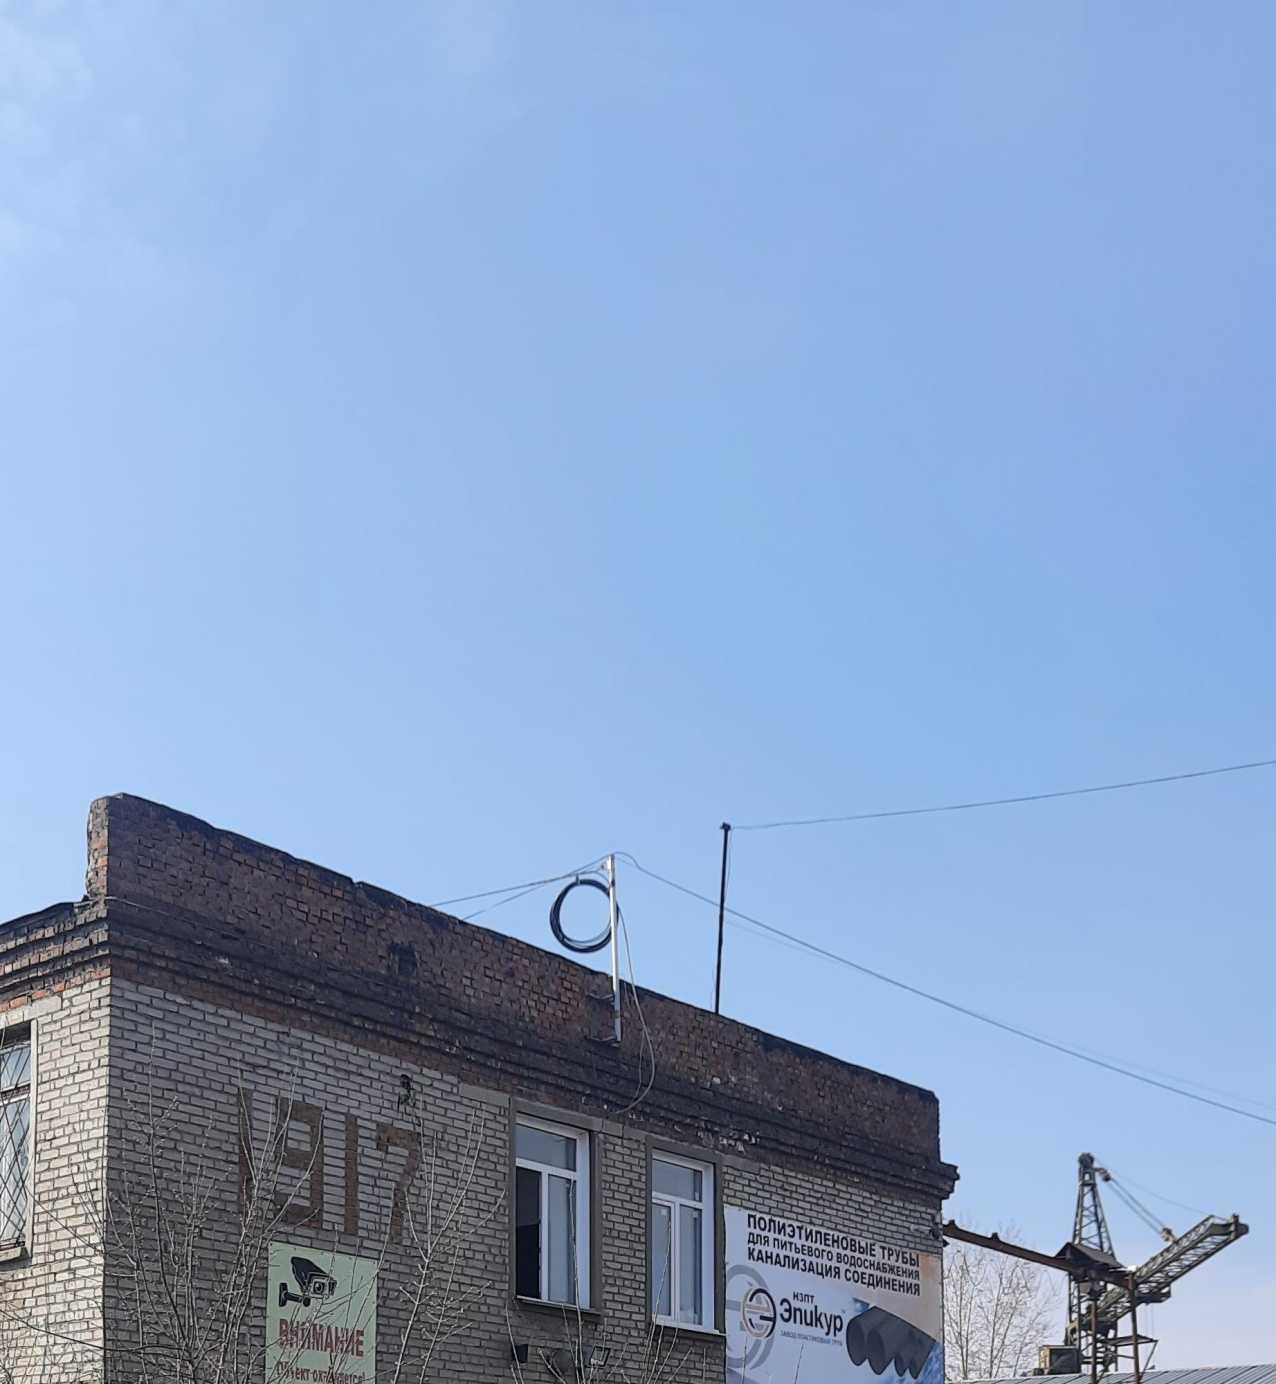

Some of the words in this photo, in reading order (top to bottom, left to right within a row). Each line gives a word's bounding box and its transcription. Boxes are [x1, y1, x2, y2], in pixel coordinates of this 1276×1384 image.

[239, 1086, 420, 1240] 1917
[747, 1213, 876, 1258] ПОЛИЭТИЛЕНОВЫЕ
[879, 1245, 920, 1267] ТРУБЫ
[747, 1232, 770, 1246] ДЛЯ
[773, 1238, 833, 1261] ПИТЬЕВОГО
[836, 1253, 920, 1281] ВОДОСНАБЖЕНИЯ
[747, 1246, 841, 1280] КАНАЛИЗАЦИЯ
[844, 1268, 921, 1297] СОЕДИНЕНИЯ
[779, 1297, 844, 1338] Эпикур
[792, 1291, 815, 1304] НЗПТ
[279, 1318, 365, 1358] ВНИМАНИЕ
